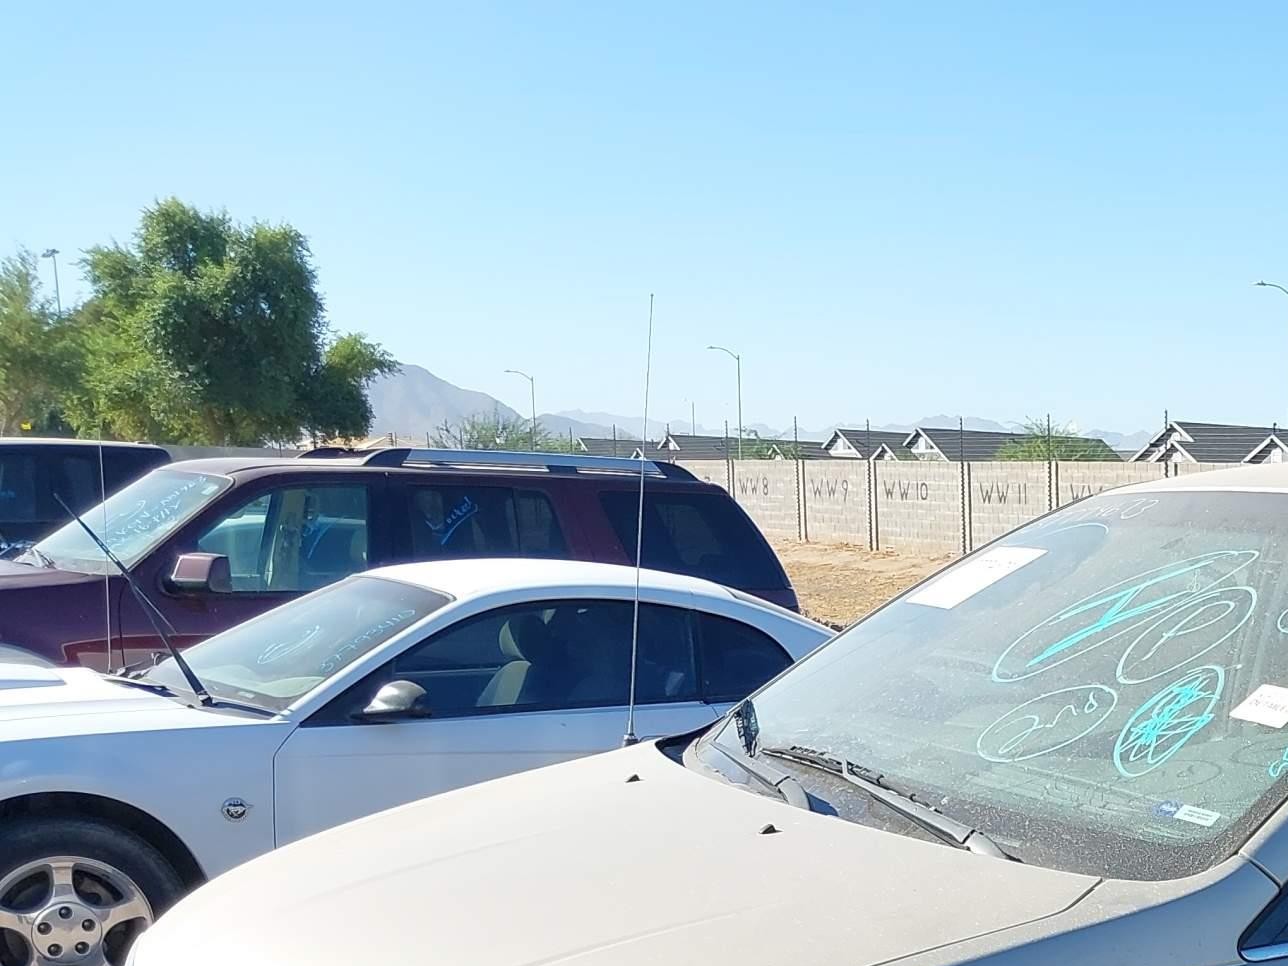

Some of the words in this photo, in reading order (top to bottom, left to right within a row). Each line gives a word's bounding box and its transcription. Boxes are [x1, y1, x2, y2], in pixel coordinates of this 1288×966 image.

[738, 476, 759, 496] WW
[762, 476, 770, 497] 8
[810, 478, 838, 499] WW
[841, 478, 849, 503] 9
[883, 479, 911, 501] WW
[915, 482, 929, 501] 10
[979, 481, 1010, 505] WW
